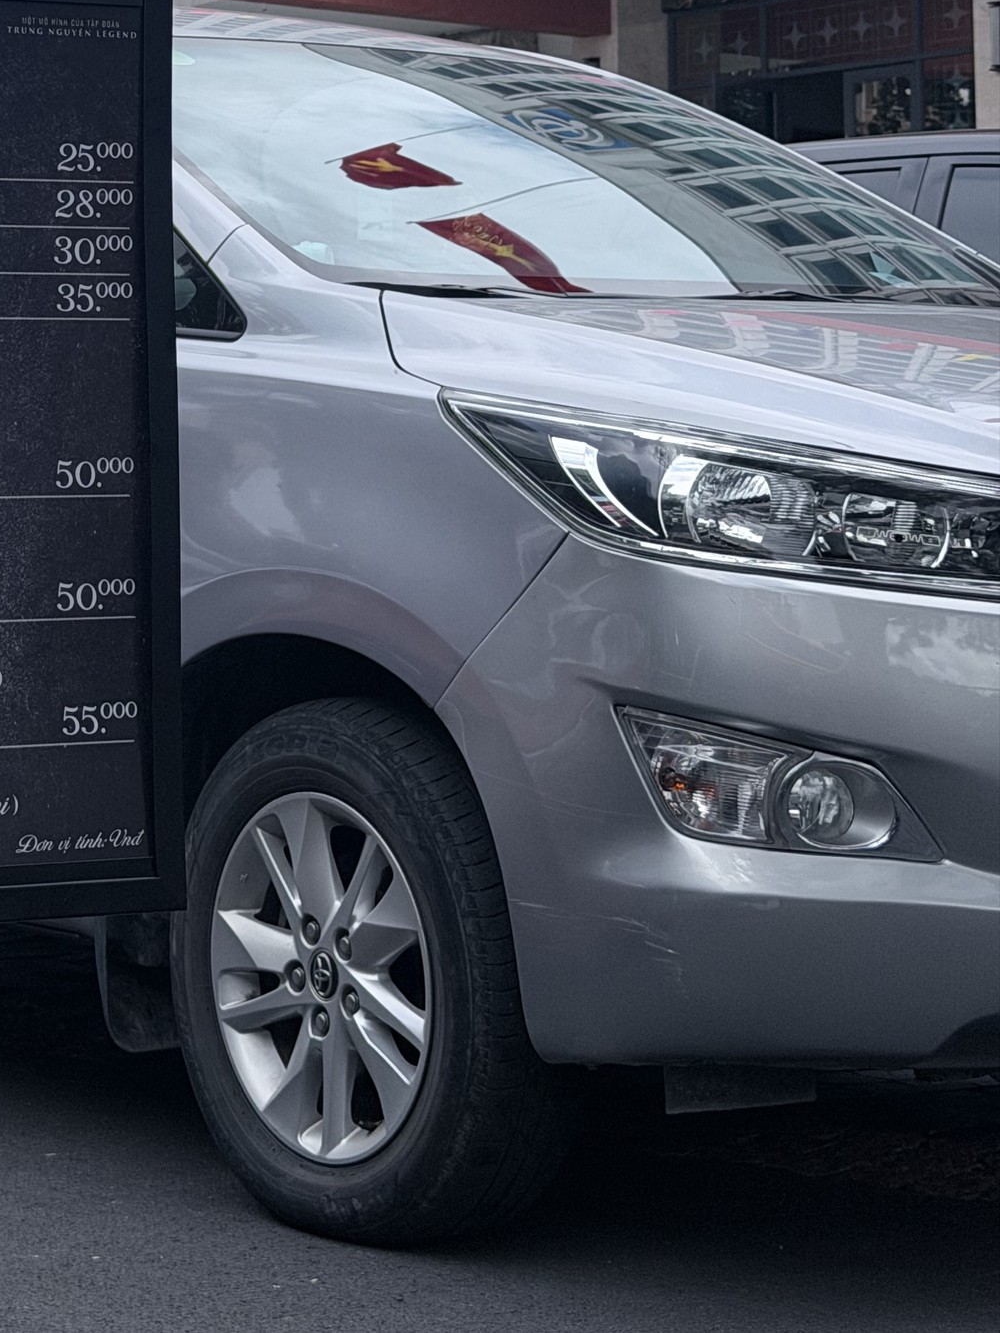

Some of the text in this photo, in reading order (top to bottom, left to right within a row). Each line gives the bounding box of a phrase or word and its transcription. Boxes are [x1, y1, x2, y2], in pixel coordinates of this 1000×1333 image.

[7, 26, 44, 35] TRUNG
[96, 30, 137, 39] LEGEND
[57, 141, 134, 172] 25.000
[55, 188, 133, 218] 28.000
[54, 235, 133, 265] 30.000
[56, 282, 133, 312] 35.000
[55, 457, 134, 489] 50.000
[56, 578, 135, 611] 50.000
[62, 701, 138, 736] 55.000
